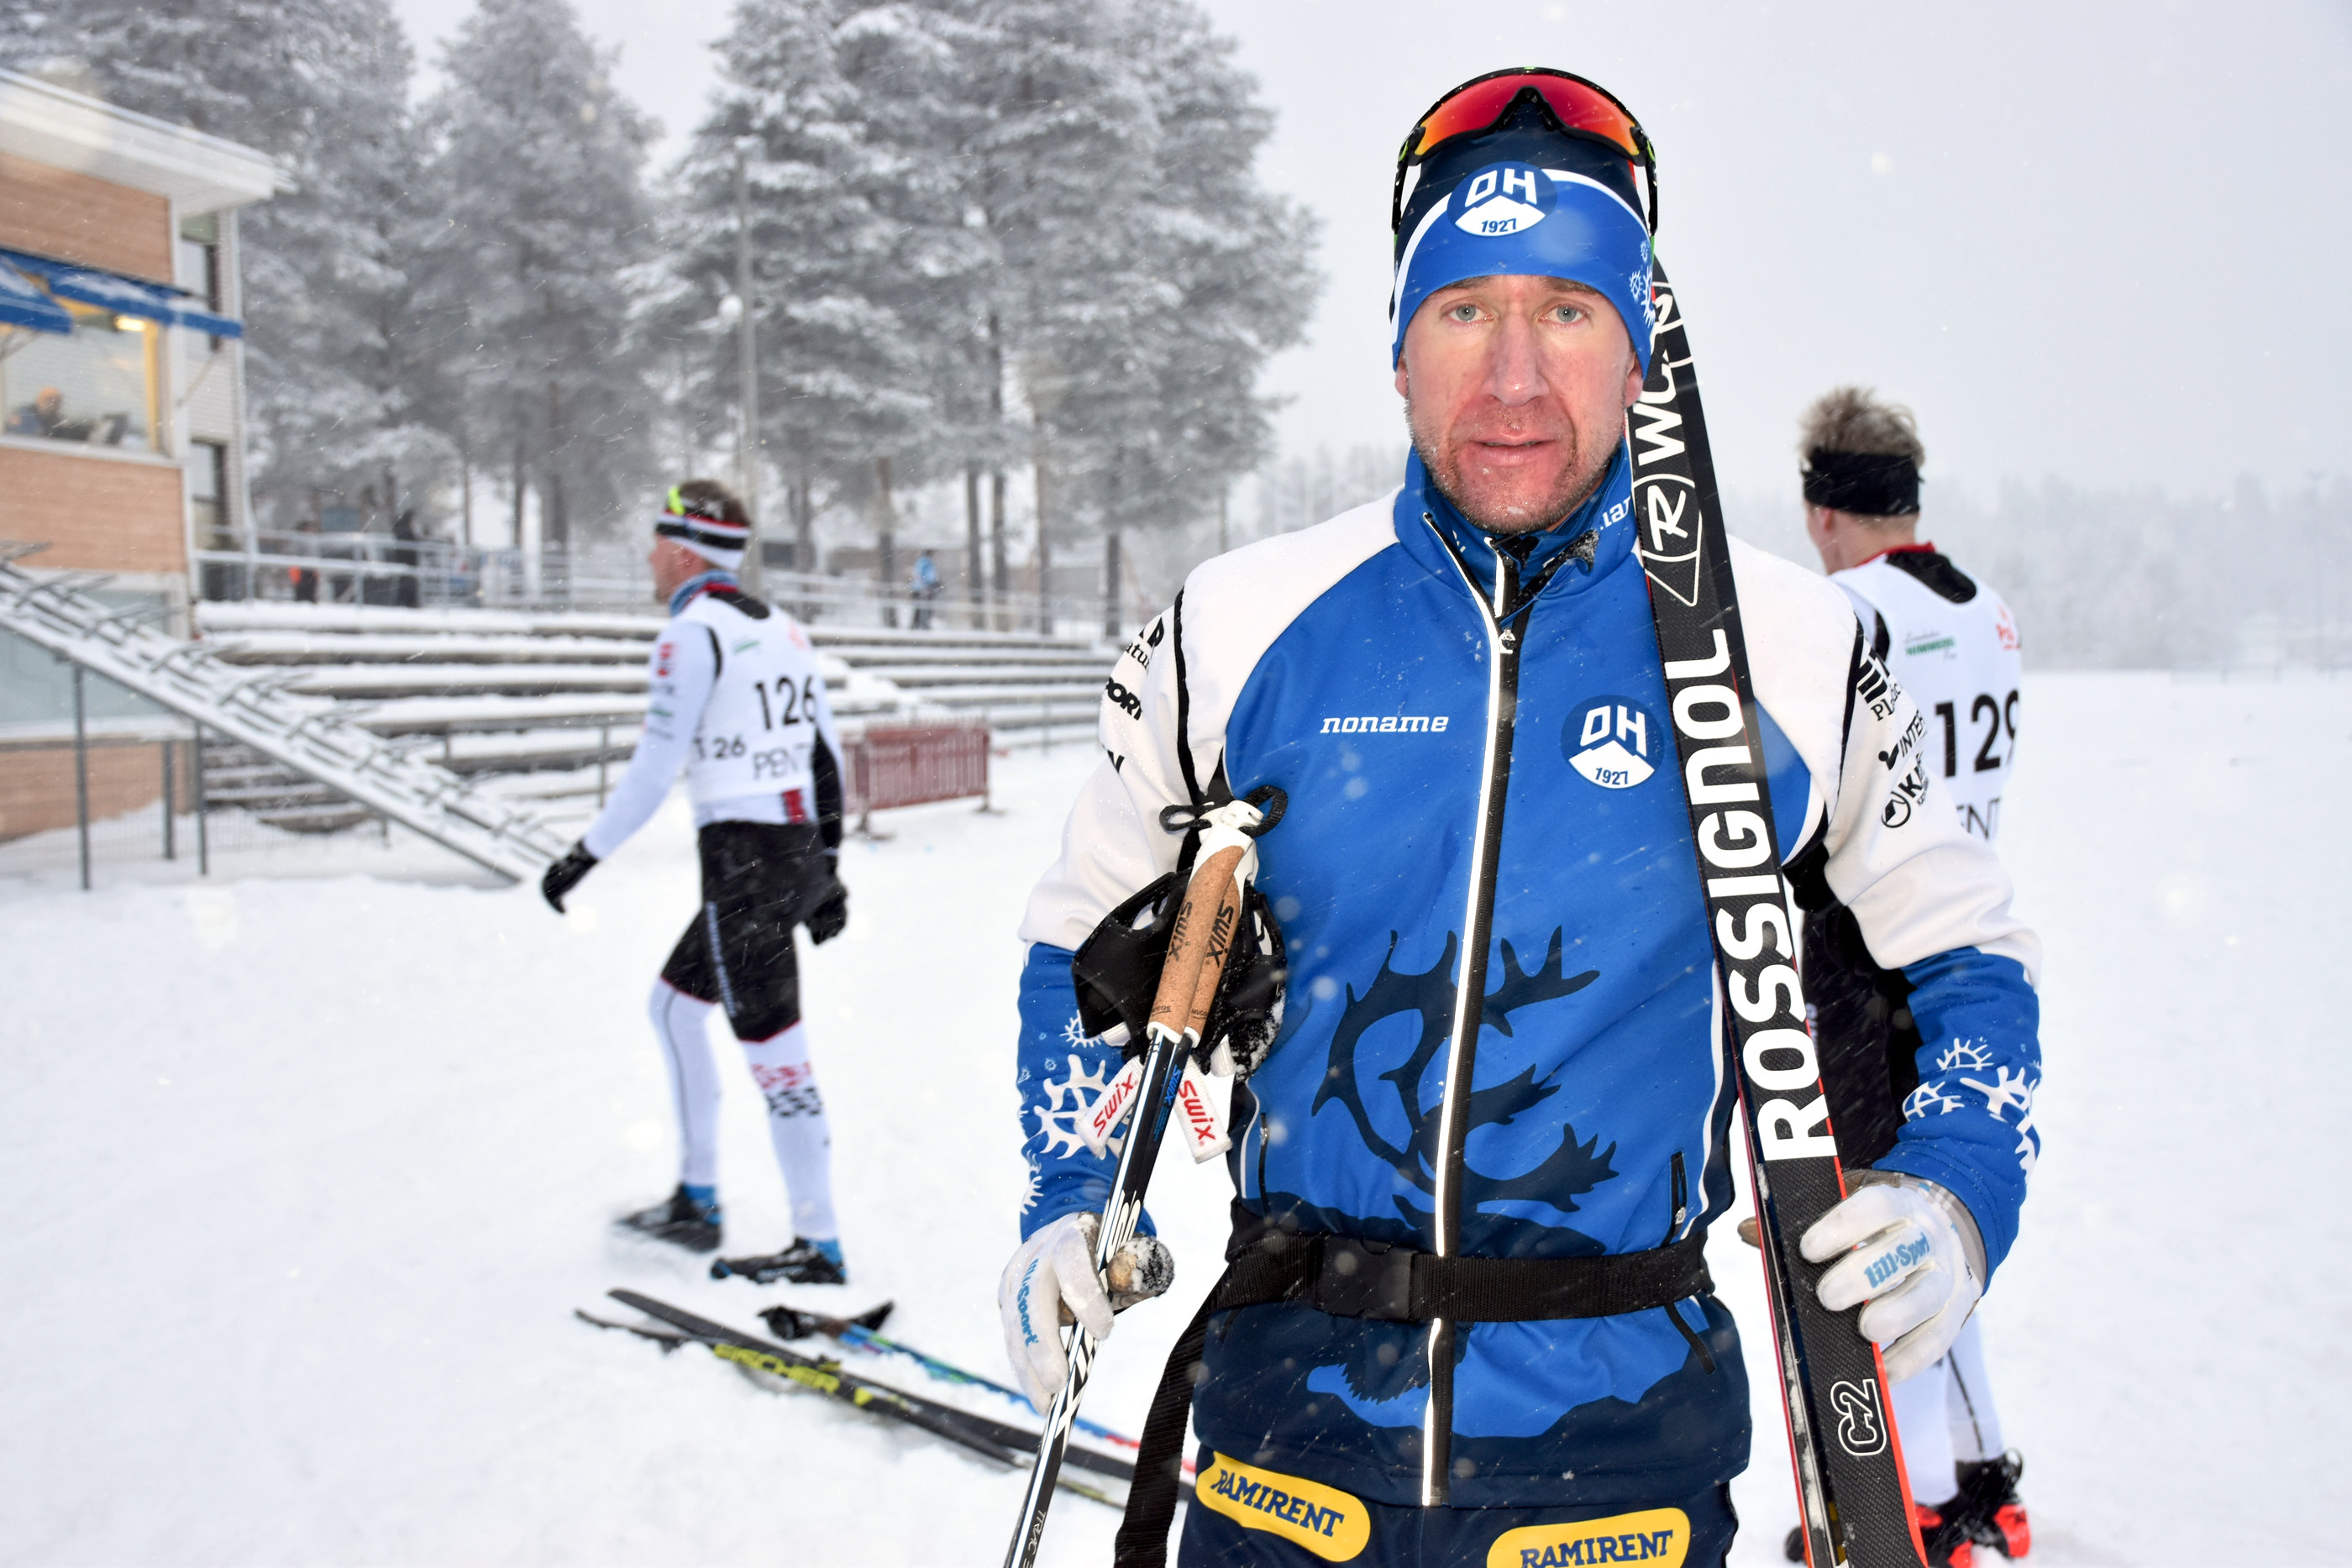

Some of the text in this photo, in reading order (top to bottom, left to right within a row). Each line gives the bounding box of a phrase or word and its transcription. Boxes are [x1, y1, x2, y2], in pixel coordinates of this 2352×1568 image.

[1480, 218, 1517, 233] 1927
[754, 674, 816, 730] 126
[1320, 716, 1449, 734] noname
[693, 733, 747, 760] 126
[1935, 688, 2019, 778] 129
[1594, 766, 1629, 786] 1927
[1664, 628, 1838, 1161] ROSSIGNOL
[1830, 1378, 1887, 1456] C2
[1210, 1468, 1346, 1538] RAMIRENT
[1520, 1529, 1674, 1568] RAMIRENT
